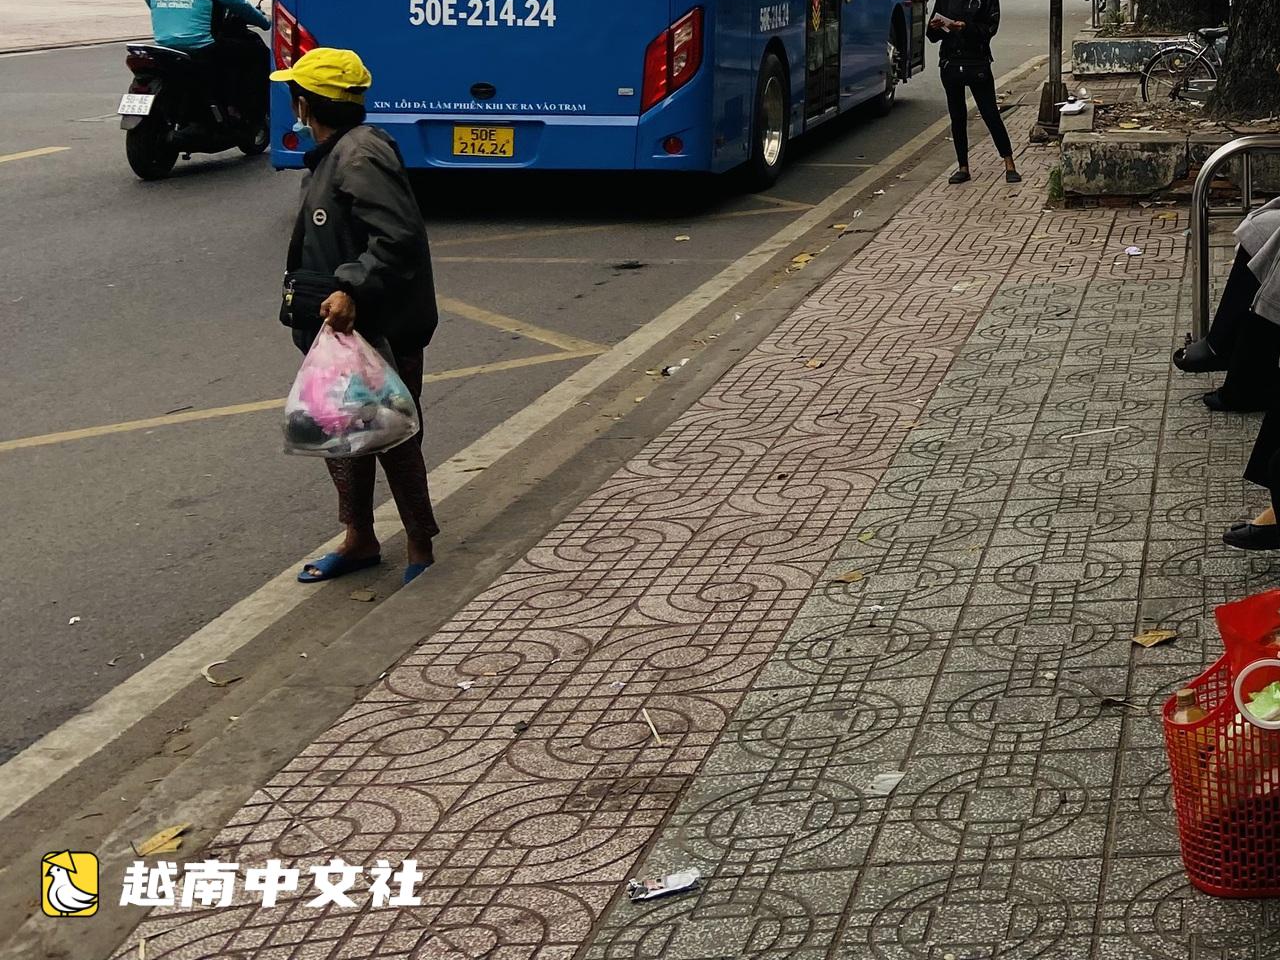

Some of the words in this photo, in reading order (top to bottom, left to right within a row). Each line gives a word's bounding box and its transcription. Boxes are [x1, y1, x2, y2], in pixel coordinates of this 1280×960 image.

[373, 101, 390, 109] XIN
[394, 99, 411, 109] LỖI
[430, 100, 452, 110] LÀM
[453, 99, 484, 110] PHIỀN
[485, 102, 504, 110] KHI
[520, 103, 533, 111] RA
[535, 102, 556, 111] VÀO
[558, 103, 587, 112] TRẠM
[470, 128, 497, 142] 50E
[459, 142, 507, 156] 214.24
